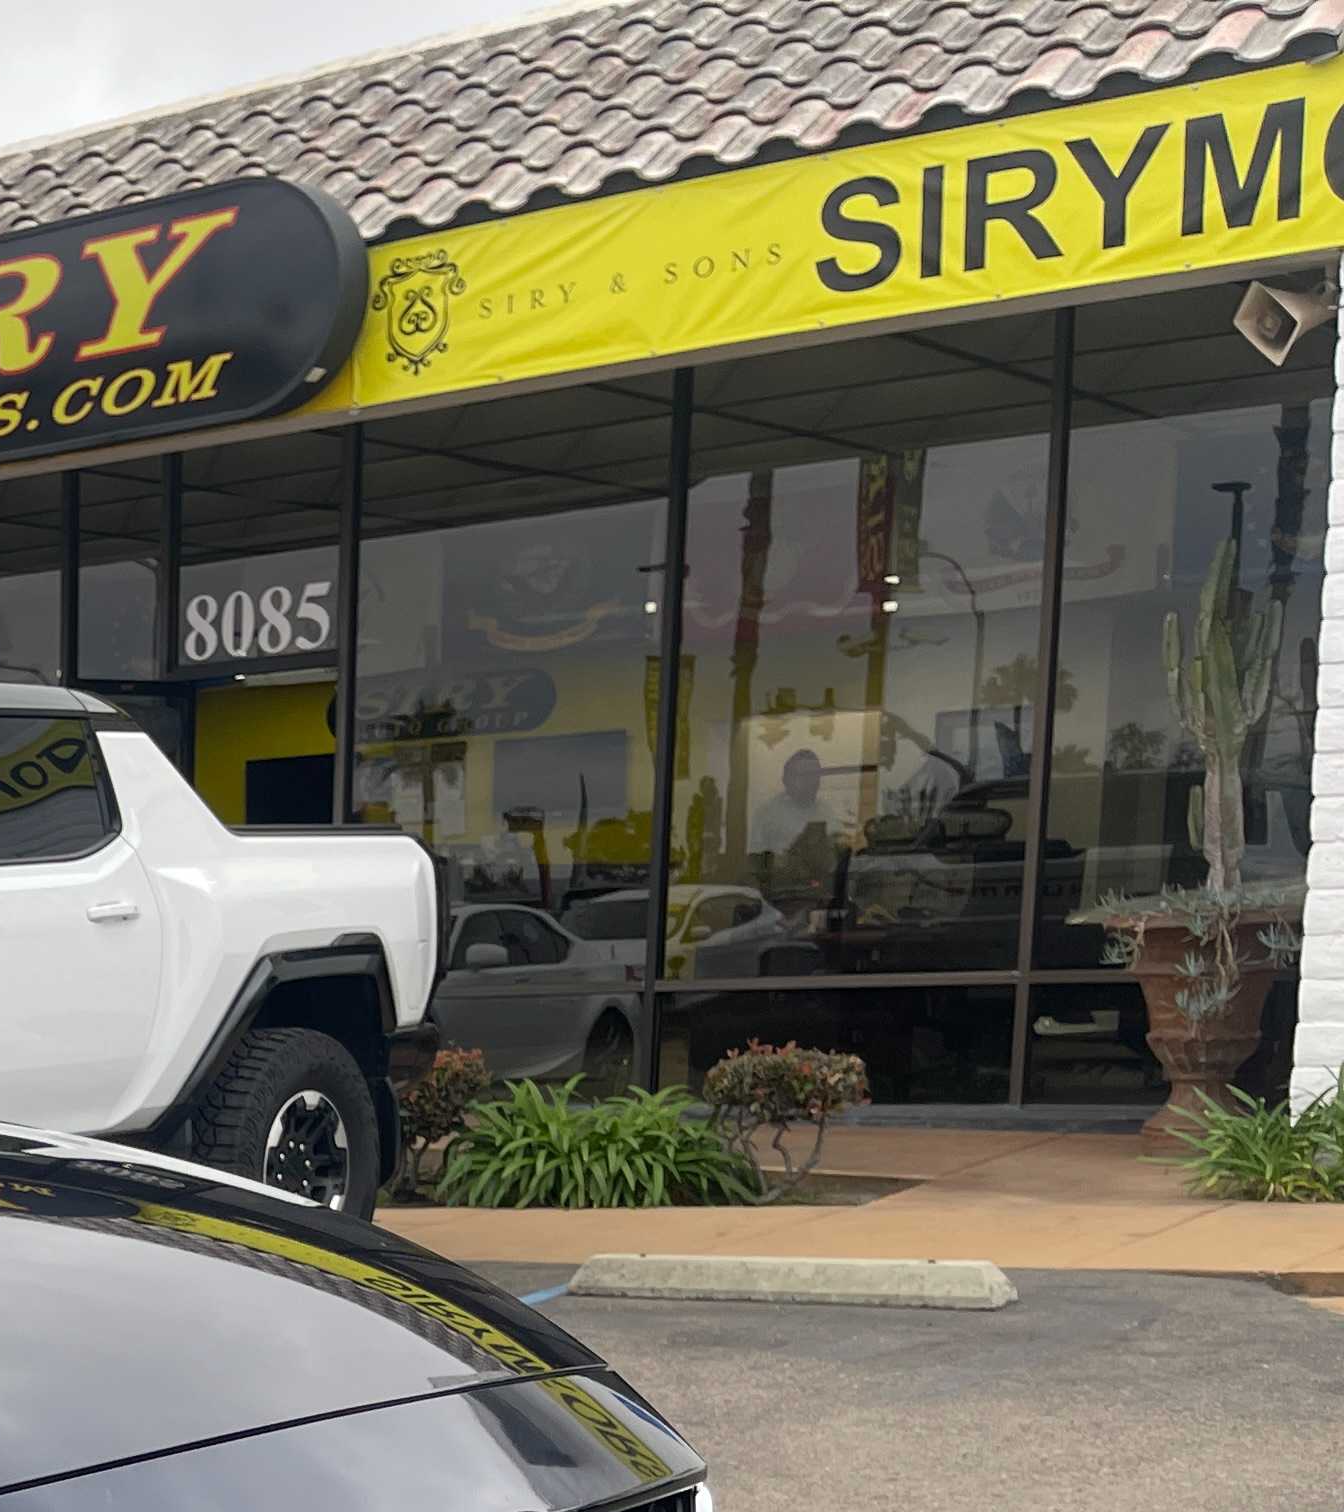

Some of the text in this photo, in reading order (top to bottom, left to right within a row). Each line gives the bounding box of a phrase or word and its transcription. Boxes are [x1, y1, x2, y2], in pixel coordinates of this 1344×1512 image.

[477, 242, 785, 320] SIRY & SONS
[184, 581, 332, 662] 8085
